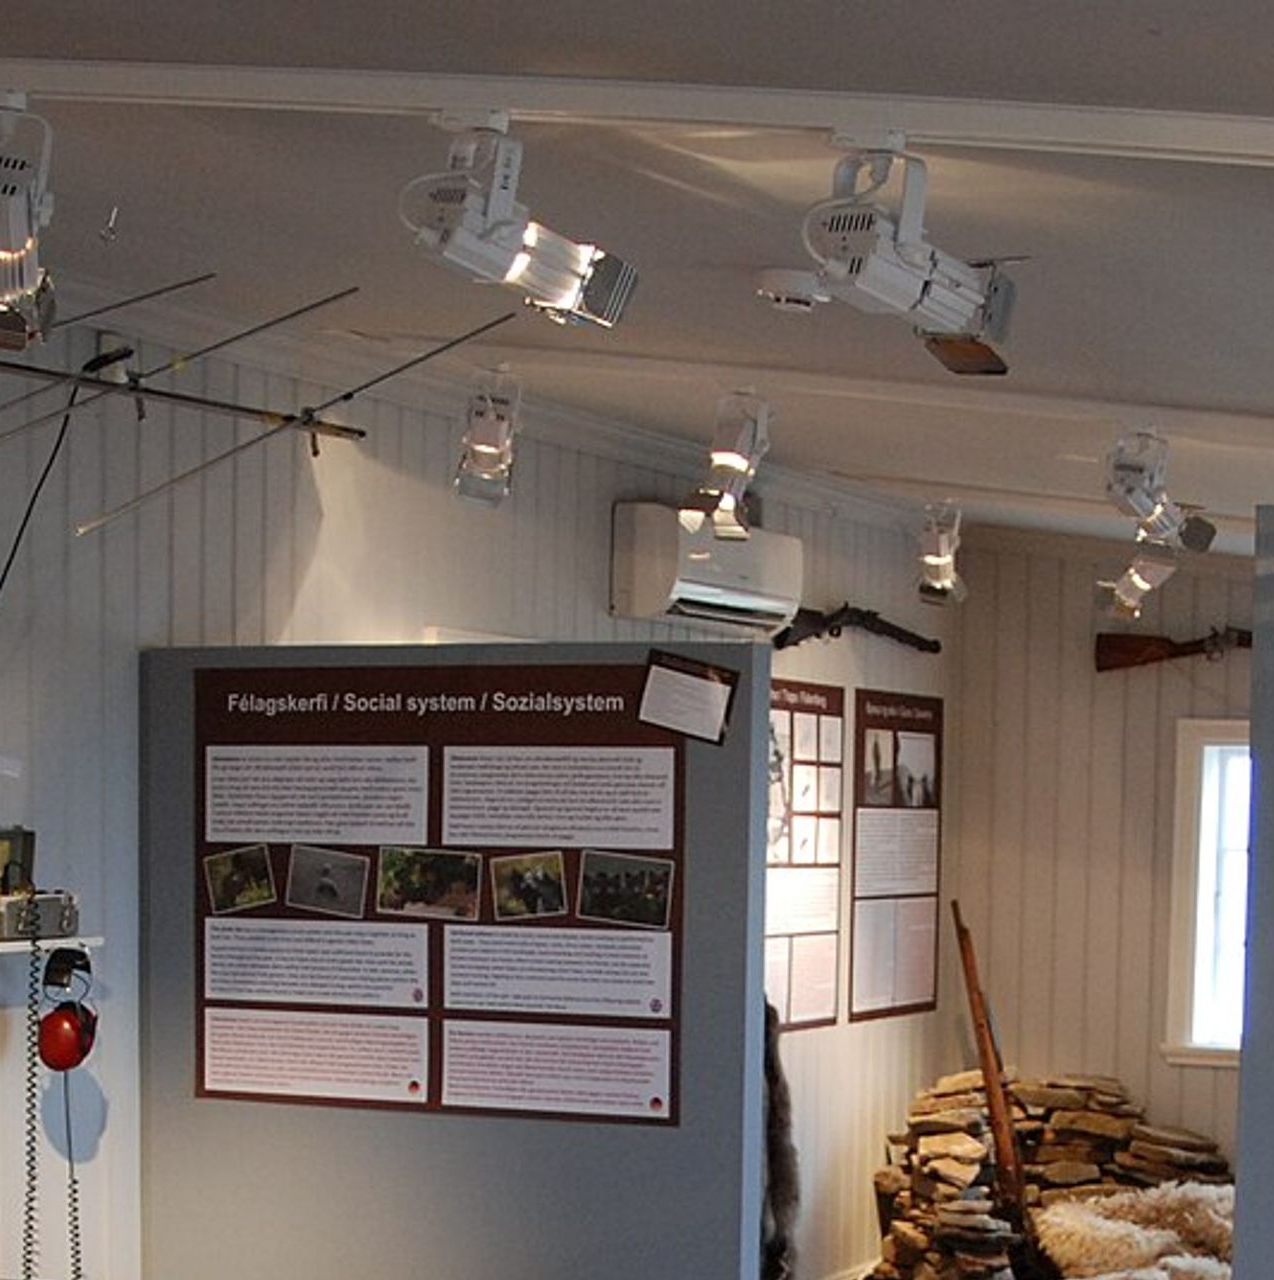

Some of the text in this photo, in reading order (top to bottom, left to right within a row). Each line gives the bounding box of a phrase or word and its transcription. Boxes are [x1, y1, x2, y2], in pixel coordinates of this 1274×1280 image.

[227, 692, 624, 716] Félagskerfi / Social system / Sozialsystem
